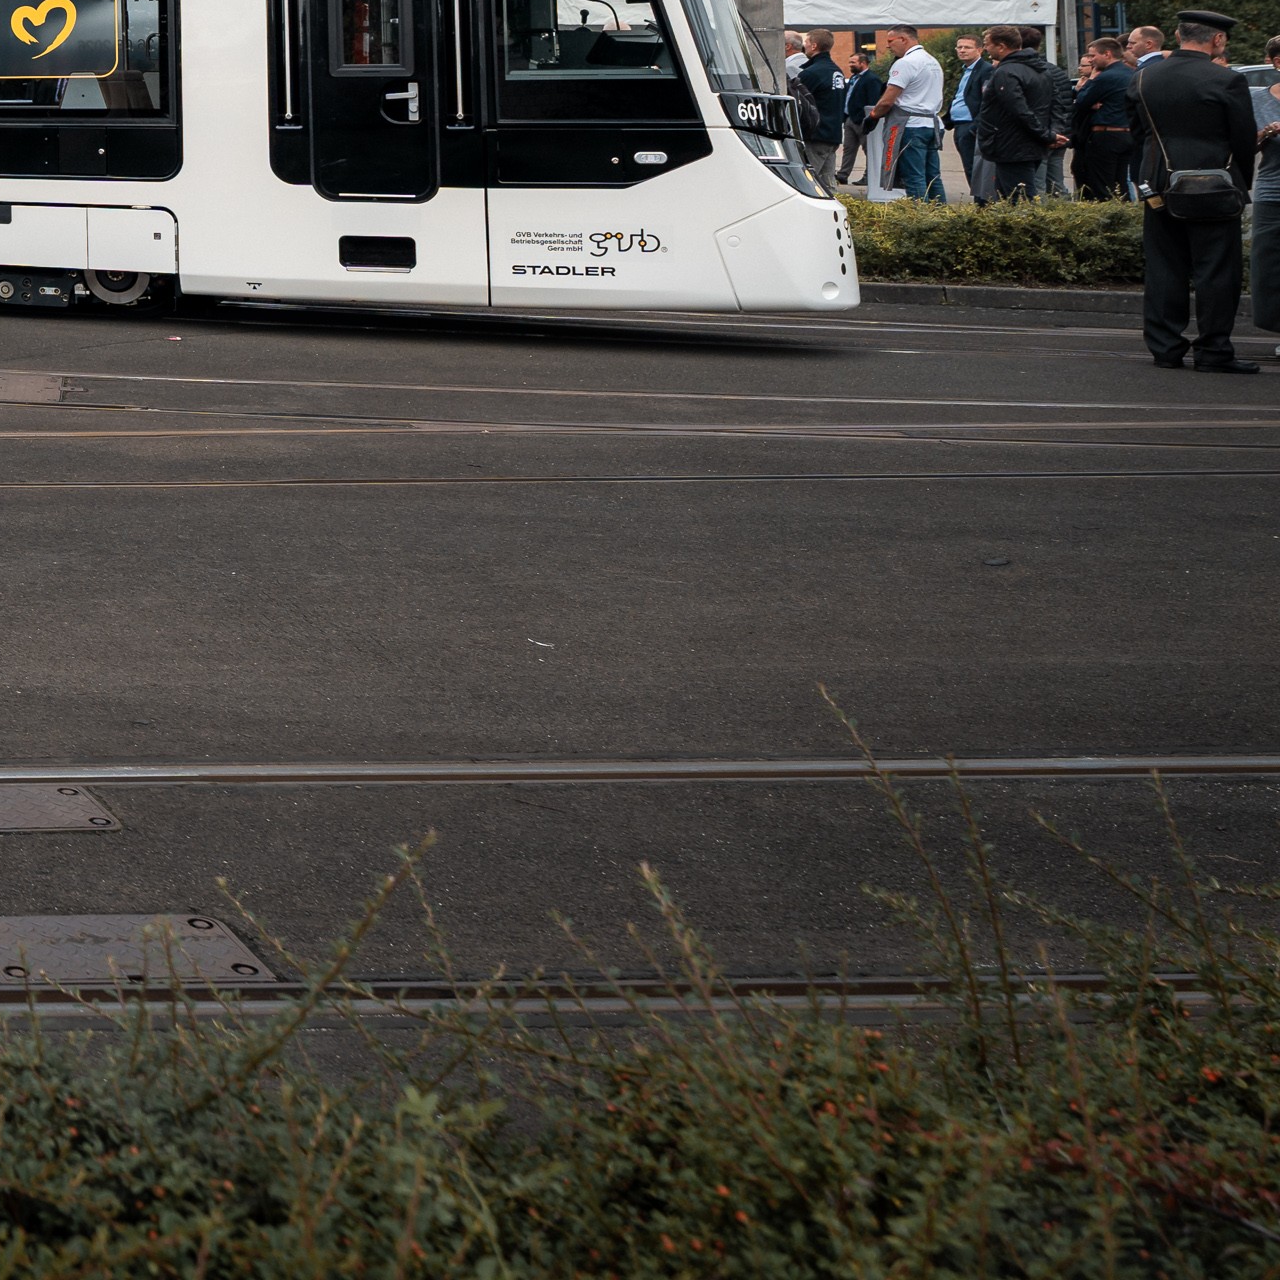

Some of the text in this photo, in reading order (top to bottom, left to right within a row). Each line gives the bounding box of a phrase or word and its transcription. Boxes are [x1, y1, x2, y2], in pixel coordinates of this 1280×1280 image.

[737, 103, 764, 121] 601
[510, 238, 583, 246] Betriebsgesellschaft
[511, 265, 616, 276] STADLER
